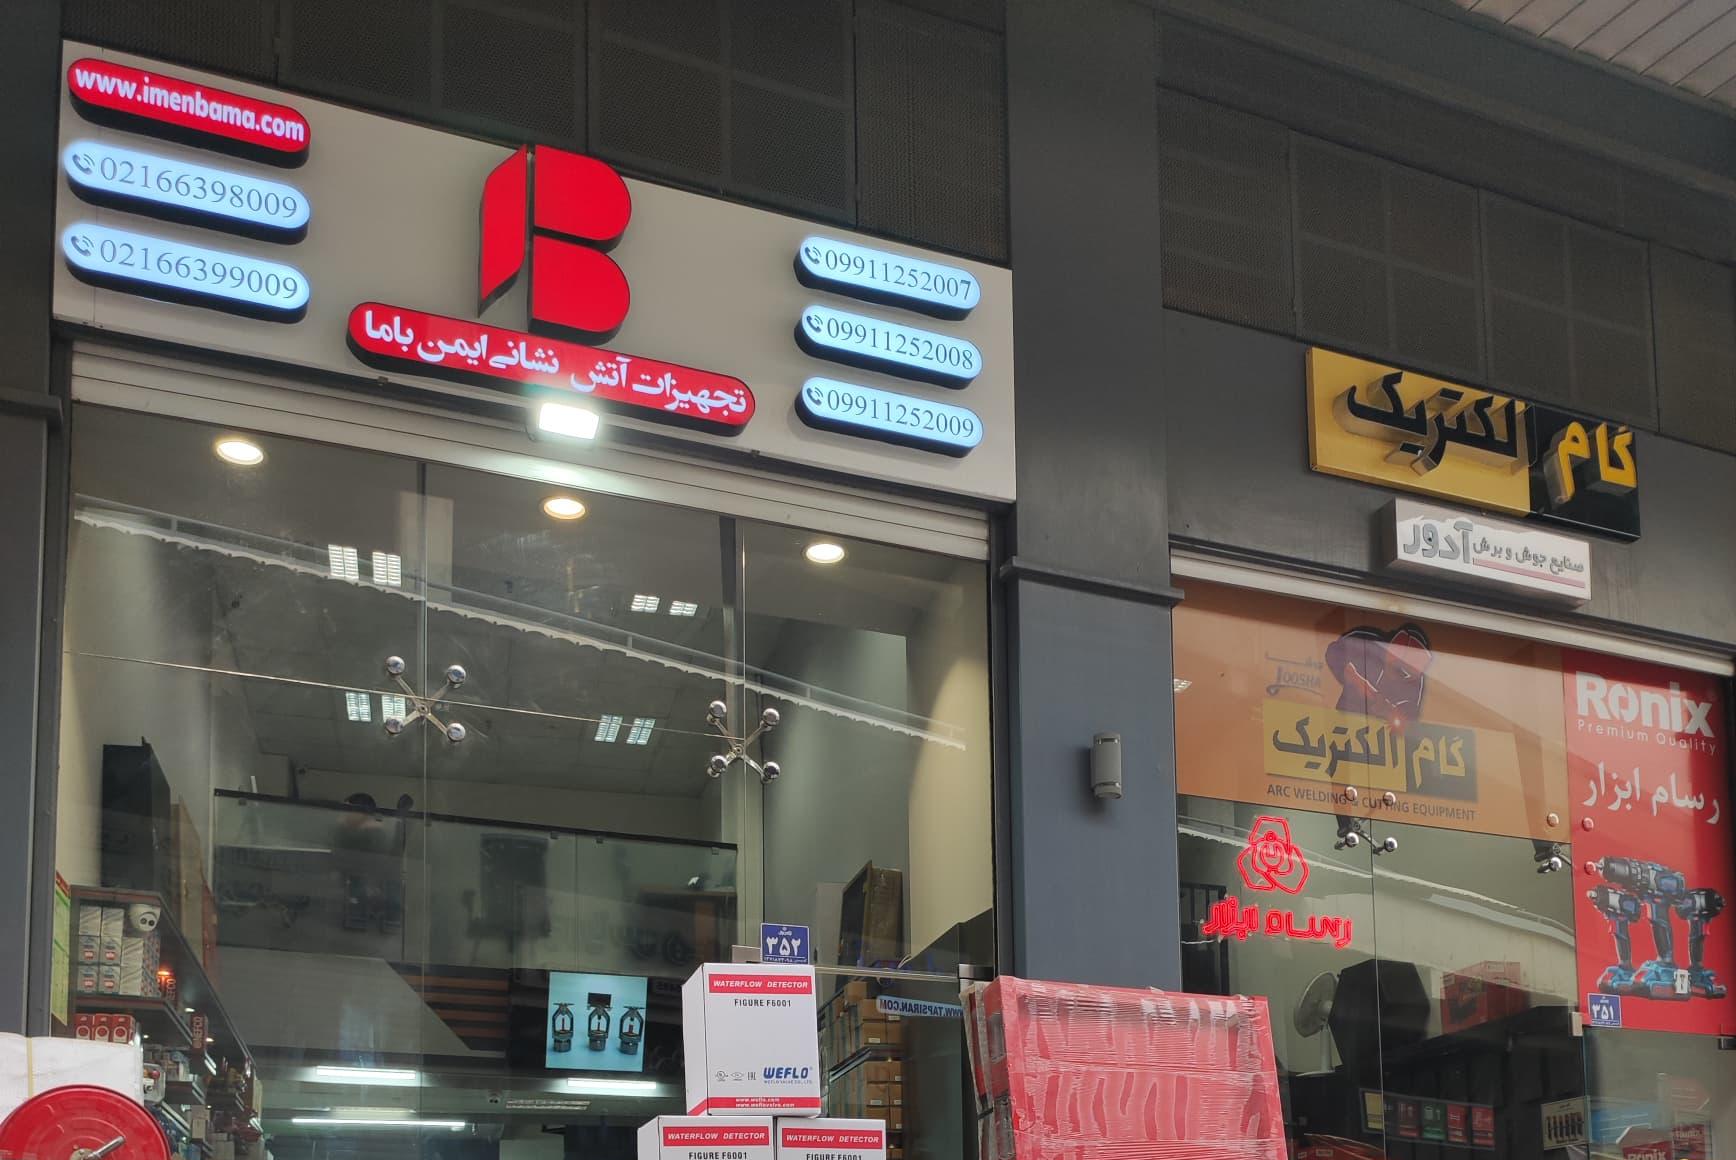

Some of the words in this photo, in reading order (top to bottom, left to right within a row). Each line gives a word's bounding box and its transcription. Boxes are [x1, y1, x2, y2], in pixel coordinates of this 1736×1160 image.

[75, 67, 305, 142] www.imenbama.com
[100, 156, 298, 219] 02166398009
[100, 238, 298, 300] 02166399009
[825, 249, 972, 300] 09911252007
[364, 311, 414, 352] باما
[417, 334, 487, 365] ایمن
[827, 317, 973, 370] 09911252008
[488, 341, 560, 374] نشانی
[570, 356, 628, 393] آتش
[632, 374, 747, 416] تجهیزات
[827, 389, 974, 438] 09911252009
[1345, 371, 1538, 476] الکتریک
[1473, 537, 1503, 559] برش
[1505, 547, 1513, 560] و
[1515, 546, 1547, 568] جوش
[1550, 555, 1584, 575] صنایع
[1576, 671, 1715, 738] Ronix
[1272, 716, 1400, 779] الکتریک
[1577, 719, 1649, 742] Premium
[1656, 733, 1717, 756] Quality
[1267, 783, 1291, 798] ARC
[1294, 788, 1347, 806] WELDING
[1362, 797, 1409, 814] CUTTING
[1413, 801, 1476, 821] EQUIPMENT
[1582, 761, 1641, 811] ابزار
[1652, 772, 1721, 825] رسام
[766, 935, 801, 957] ۳۵۲
[713, 980, 763, 988] WATERFLOW
[767, 981, 808, 989] DETECTOR
[734, 998, 764, 1007] FIGURE
[766, 999, 792, 1007] F6001
[764, 1068, 808, 1079] WEFLO
[667, 1132, 719, 1140] WATERFLOW
[723, 1132, 765, 1140] DETECTOR
[786, 1134, 835, 1142] WATERFLOW
[839, 1135, 880, 1143] DETECTOR
[688, 1151, 720, 1160] FIGURE
[722, 1151, 748, 1160] F6001
